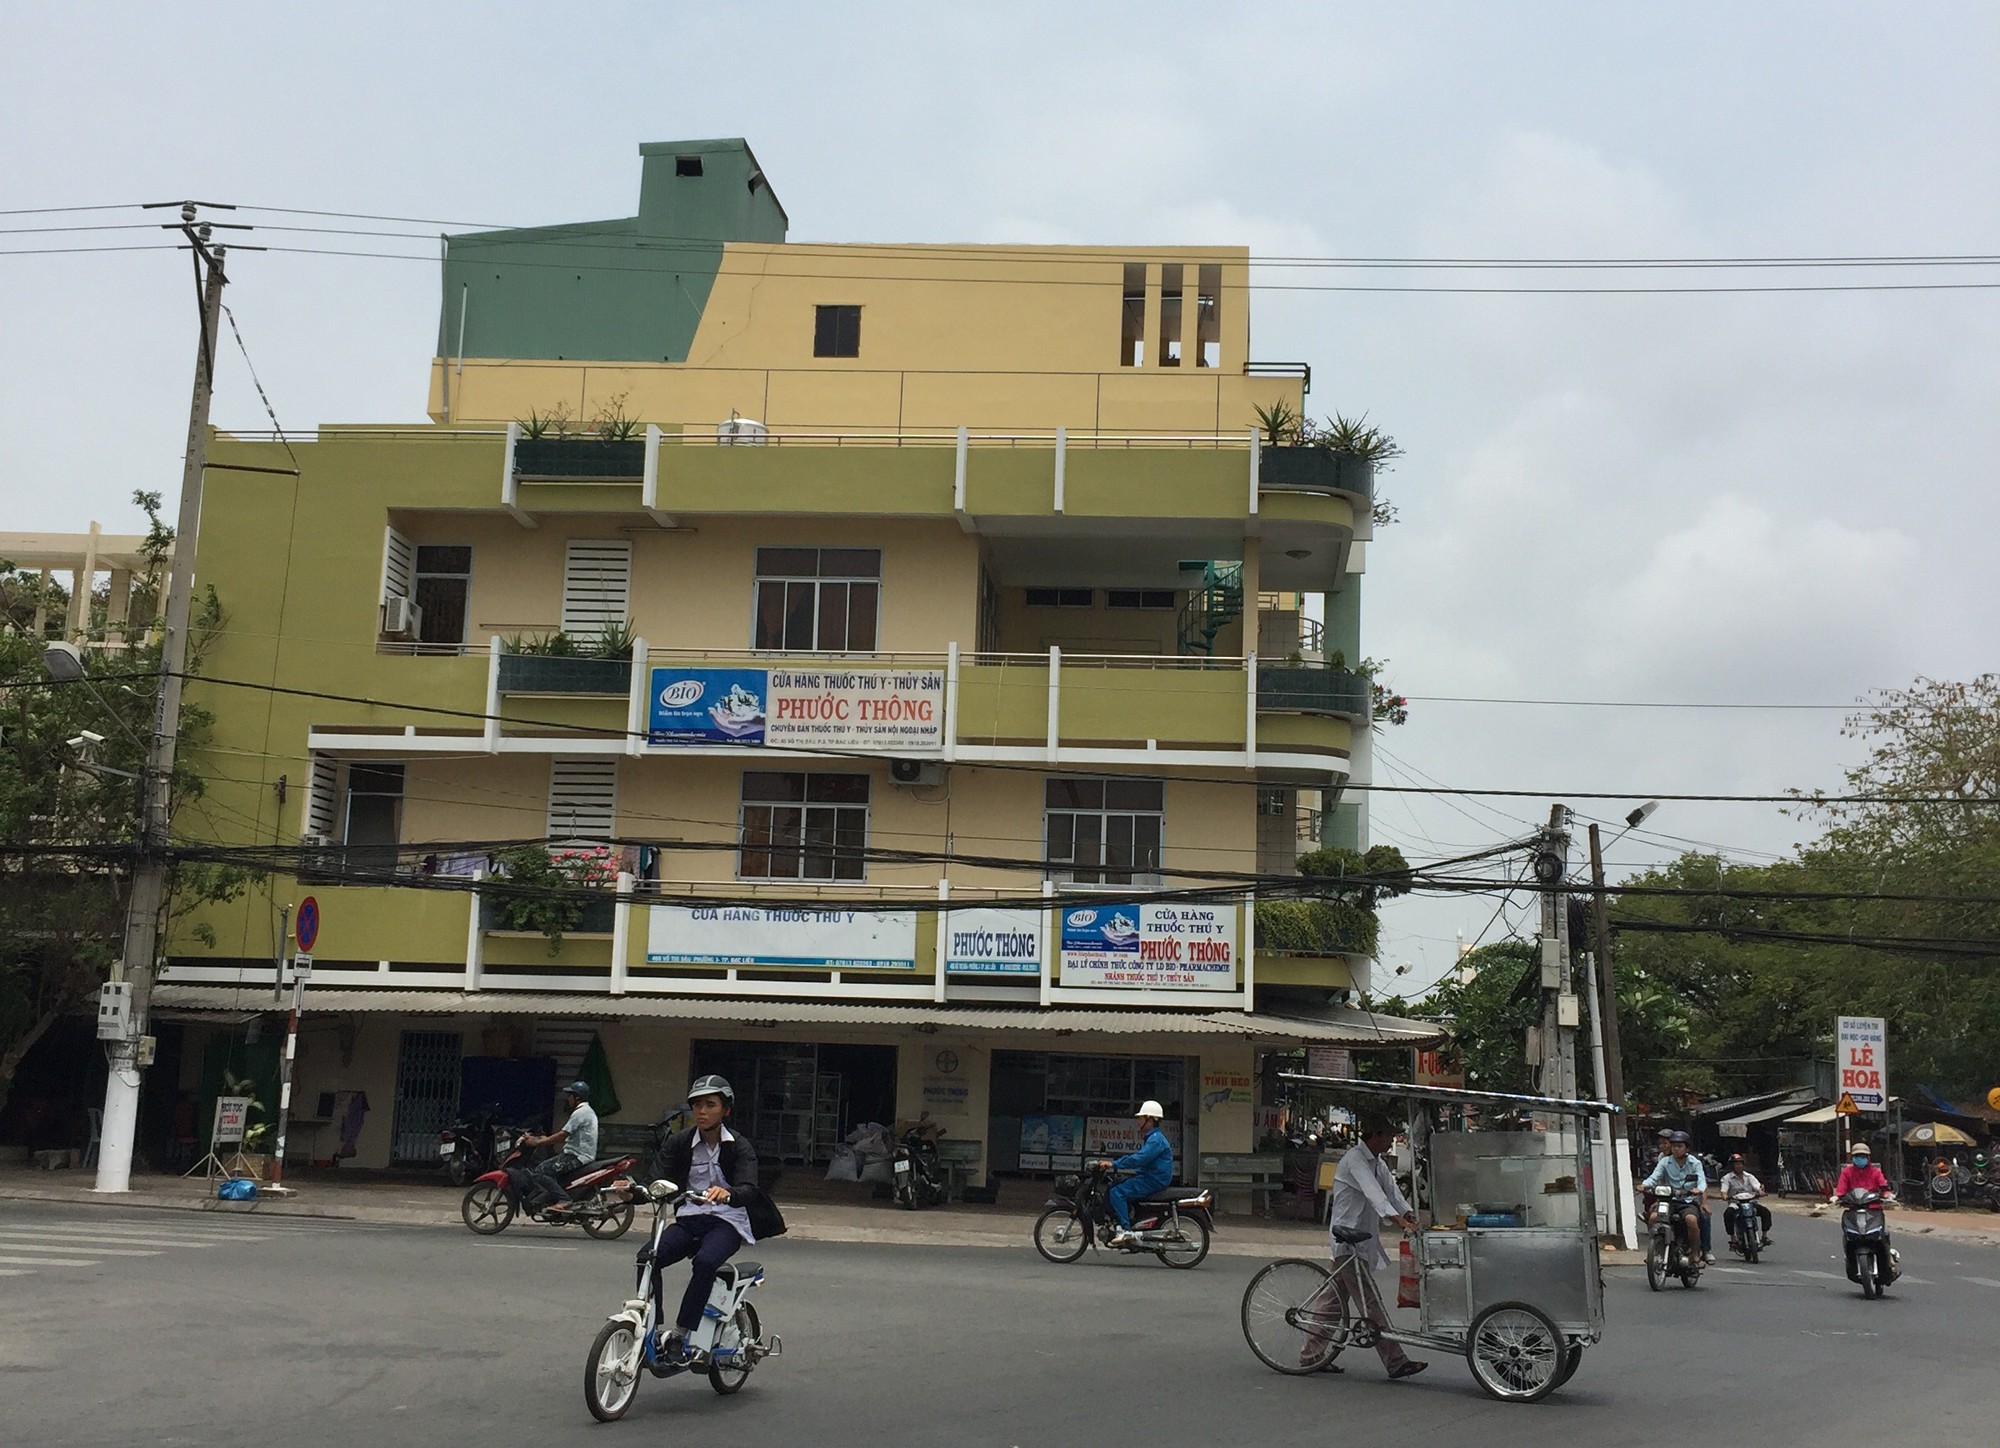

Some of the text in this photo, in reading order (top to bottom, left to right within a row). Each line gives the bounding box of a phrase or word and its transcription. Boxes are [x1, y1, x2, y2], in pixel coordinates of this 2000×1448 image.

[794, 672, 820, 689] HÀNG
[823, 671, 856, 690] THUỐC
[858, 673, 877, 690] THÚ
[880, 676, 886, 690] Y
[921, 672, 941, 690] SẢN
[776, 691, 933, 721] PHƯỚC THÔNG
[847, 912, 855, 924] Y
[1155, 908, 1214, 920] CỬA HÀNG
[1147, 920, 1224, 934] THUỐC THÚ Y
[954, 926, 1035, 957] PHƯỚC THÔNG
[1140, 934, 1230, 962] PHƯỚC THÔNG
[1850, 1042, 1873, 1066] LÊ
[1843, 1069, 1881, 1089] HOA
